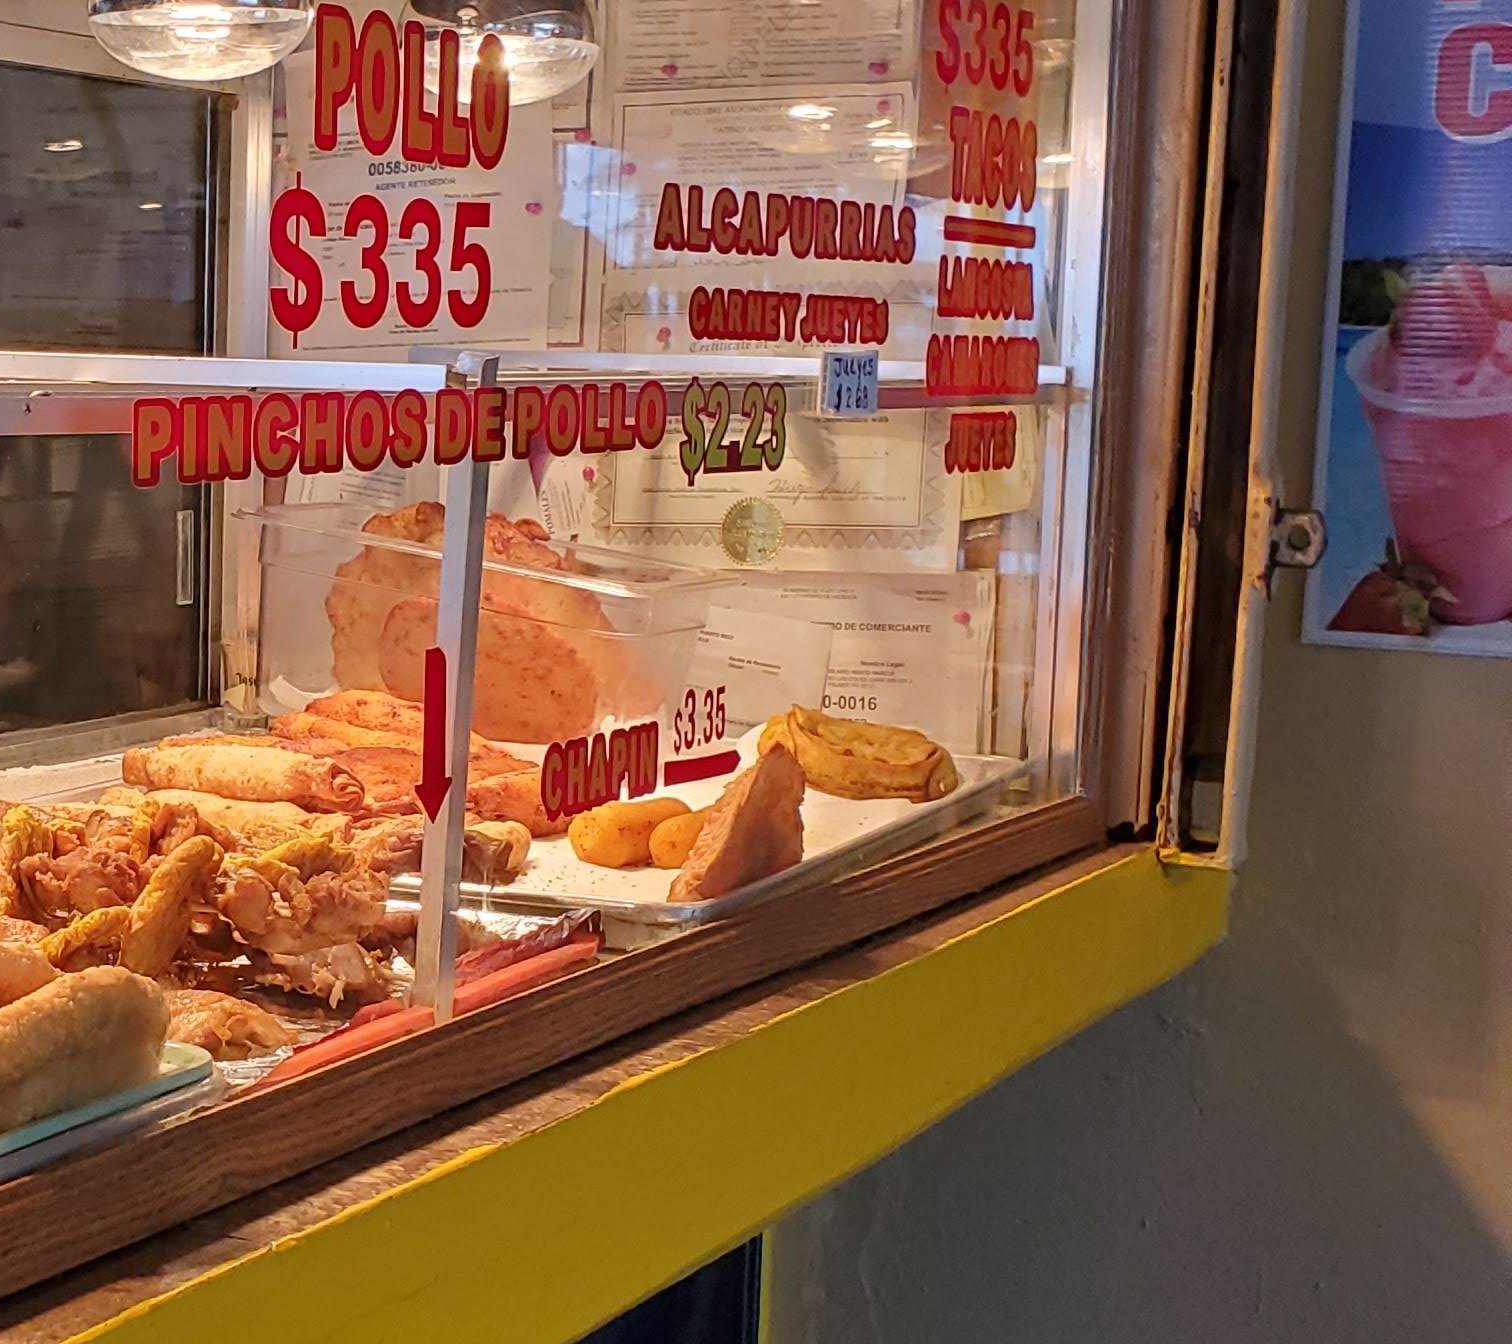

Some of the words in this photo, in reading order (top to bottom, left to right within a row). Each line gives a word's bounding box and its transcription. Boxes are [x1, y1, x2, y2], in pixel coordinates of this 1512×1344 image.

[314, 3, 509, 170] POLLO
[950, 106, 1037, 213] TACOS
[269, 171, 492, 349] $335
[654, 183, 916, 264] ALCAPURRIAS
[800, 294, 889, 345] JUEYES
[131, 389, 427, 488] PINCHOS
[434, 387, 507, 465] DE
[512, 380, 666, 460] POLLO
[844, 622, 857, 632] DE
[858, 622, 932, 634] COMERCIANTE
[541, 721, 658, 822] CHAPIN
[674, 685, 727, 756] $3.35
